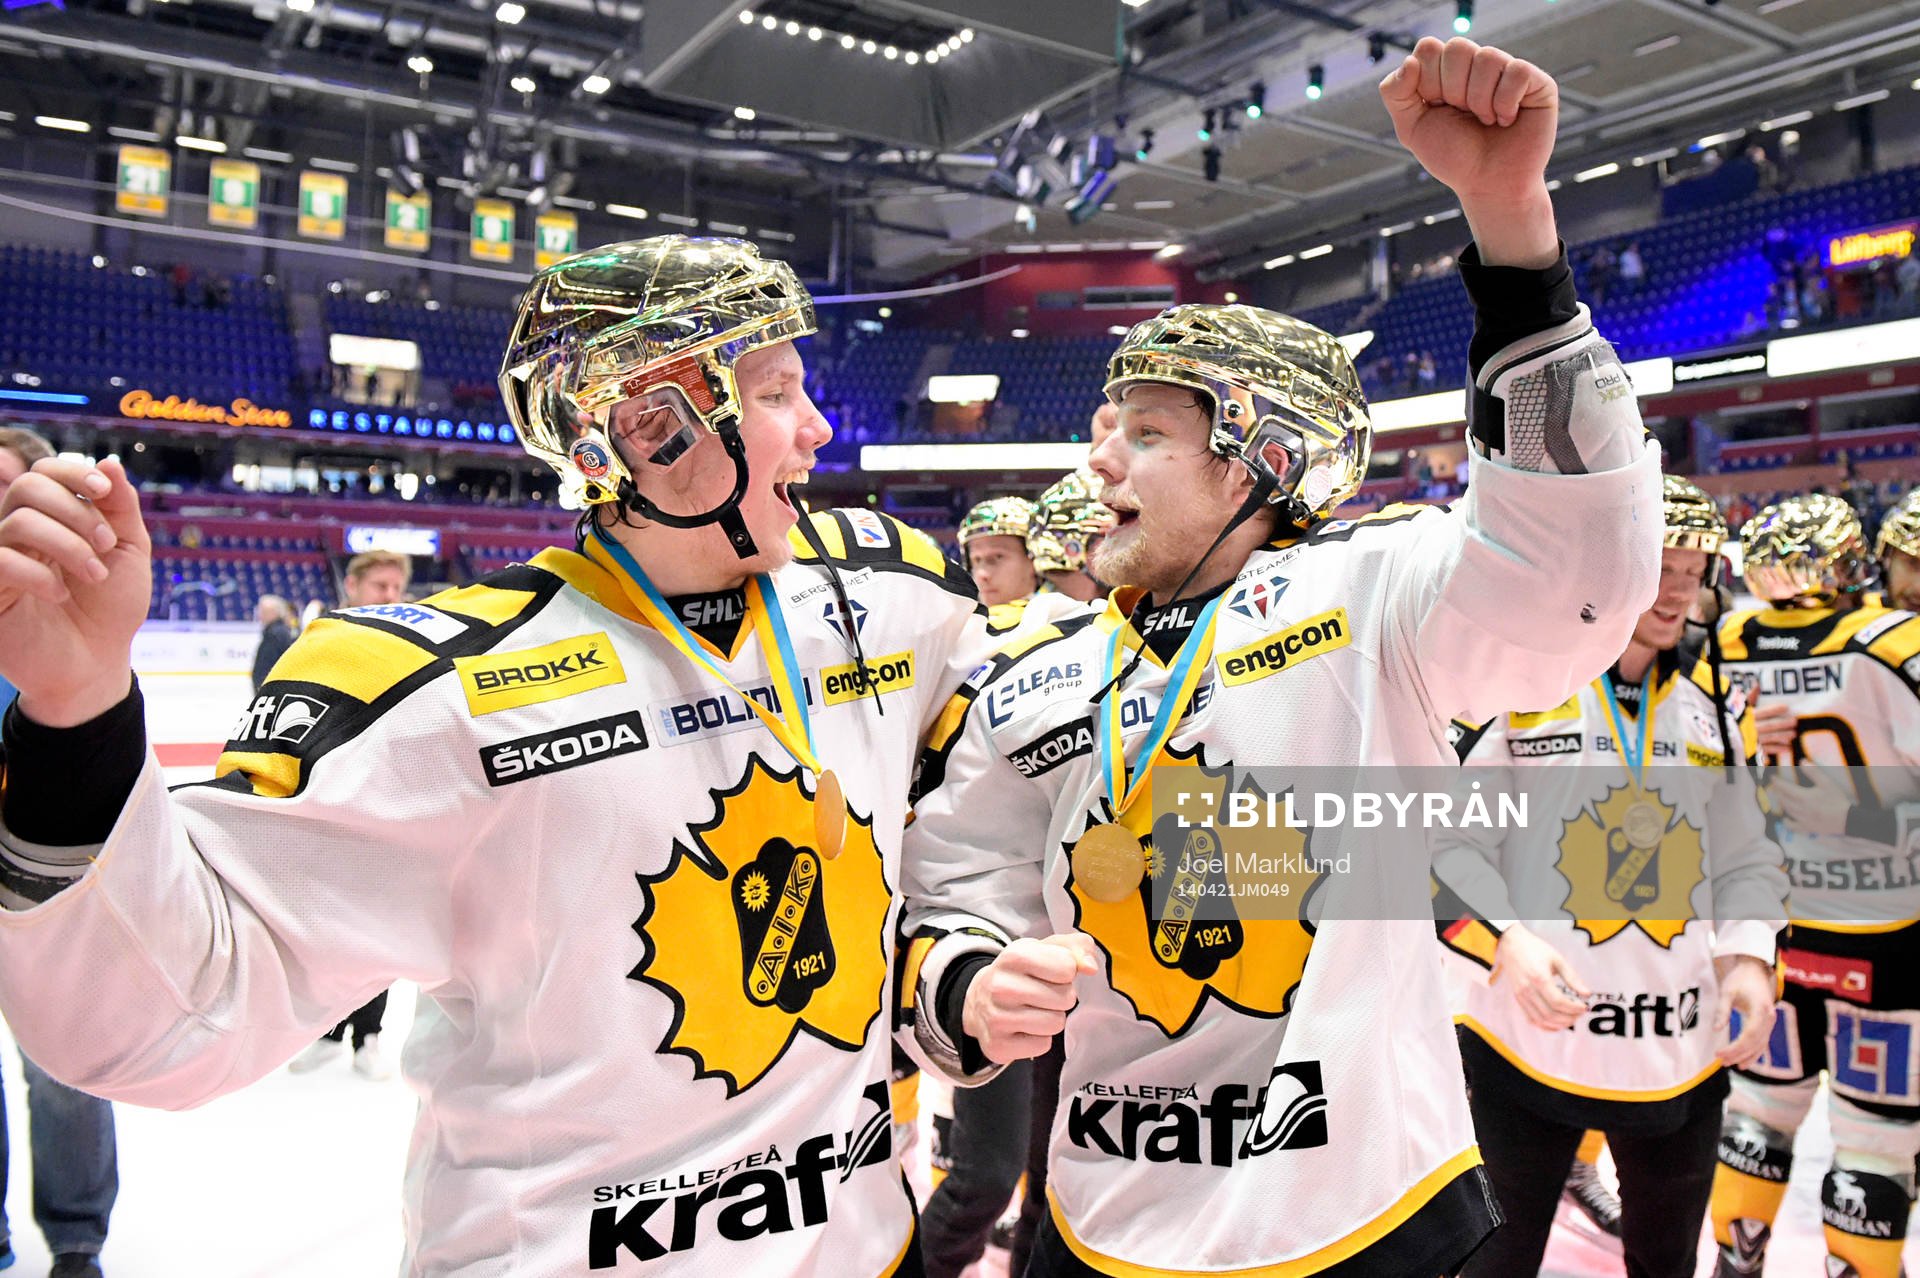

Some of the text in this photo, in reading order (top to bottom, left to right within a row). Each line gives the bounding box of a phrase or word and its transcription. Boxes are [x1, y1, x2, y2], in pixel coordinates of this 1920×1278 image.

[1237, 547, 1302, 582] GTEAMET
[791, 572, 870, 604] BERGTEMET
[683, 594, 743, 627] SHL
[1143, 606, 1194, 637] SHL
[1225, 618, 1342, 677] engcon
[473, 649, 604, 690] BROKK
[826, 659, 911, 696] engcon
[1018, 663, 1083, 696] LEAB
[1044, 680, 1082, 696] group
[1615, 684, 1641, 701] SH
[493, 723, 641, 778] ŠKODA
[1011, 728, 1094, 775] ŠKODA
[1195, 925, 1232, 948] 1921
[792, 951, 827, 980] 1921
[593, 1144, 783, 1202] SKELLEFTEÅ
